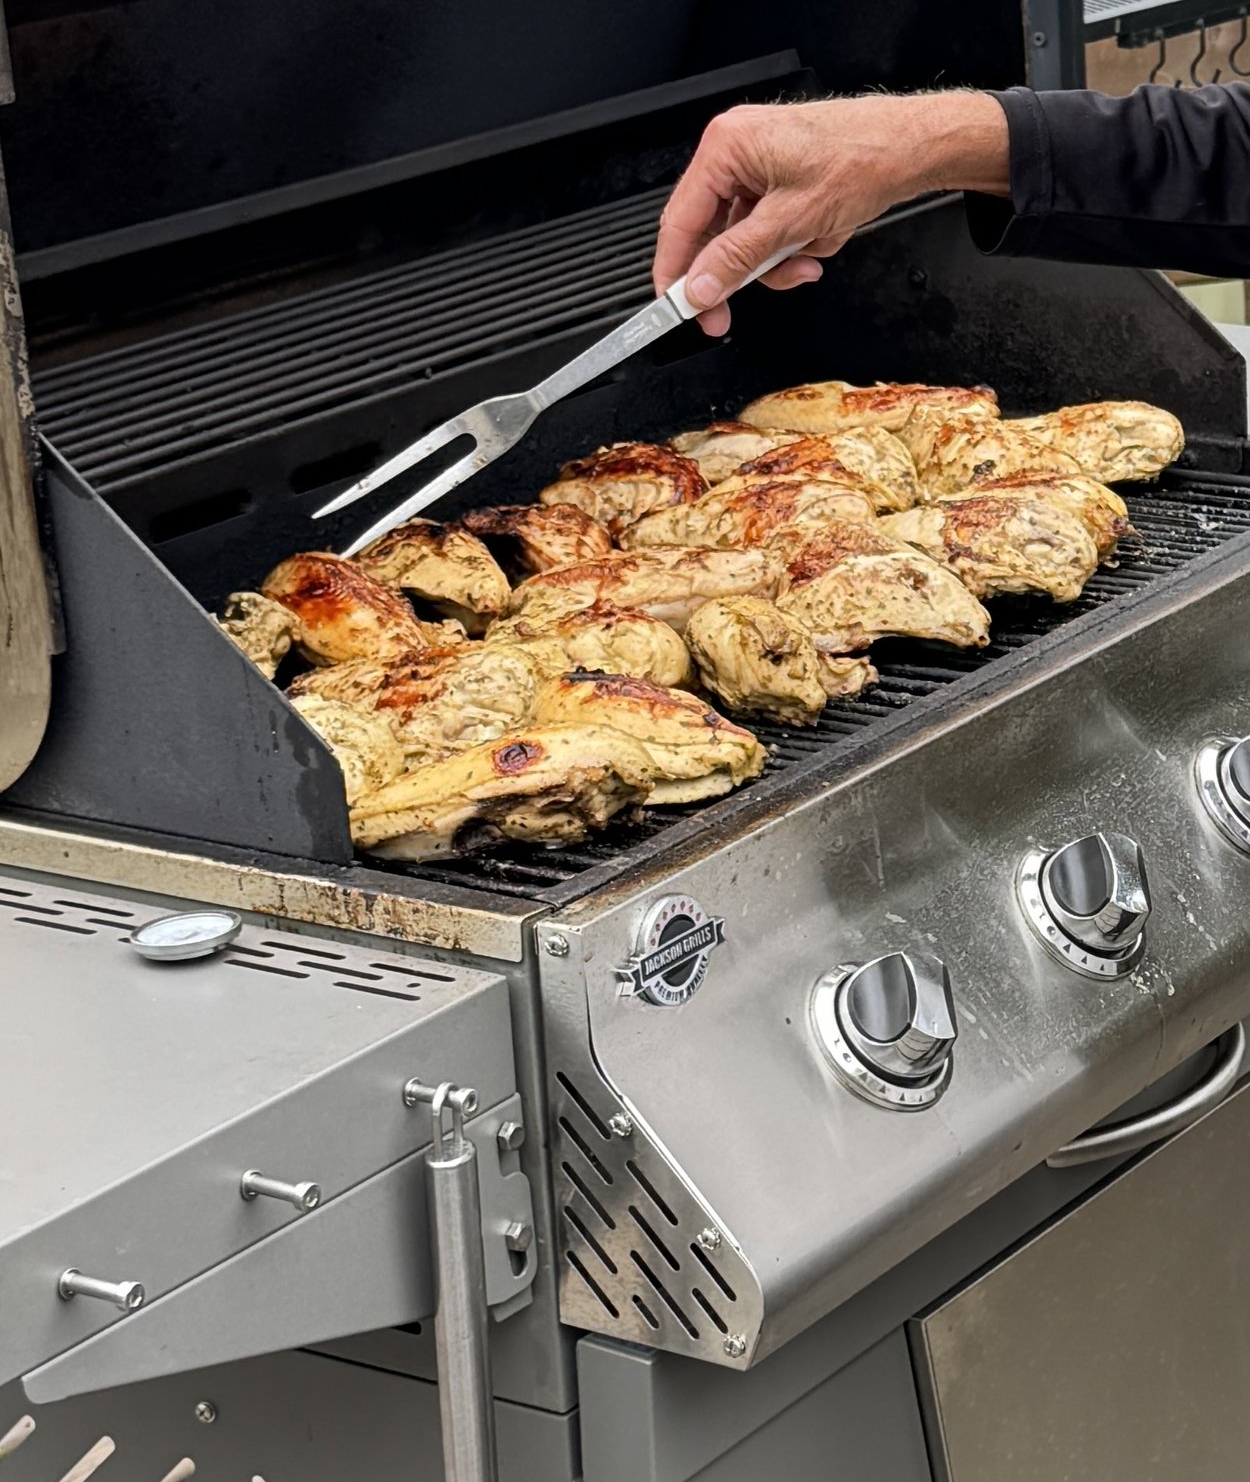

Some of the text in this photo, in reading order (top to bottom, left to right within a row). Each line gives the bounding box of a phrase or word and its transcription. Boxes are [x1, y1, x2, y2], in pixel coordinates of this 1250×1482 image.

[644, 926, 713, 977] JACKSON GRILLS
[654, 980, 685, 1004] PREMIUM
